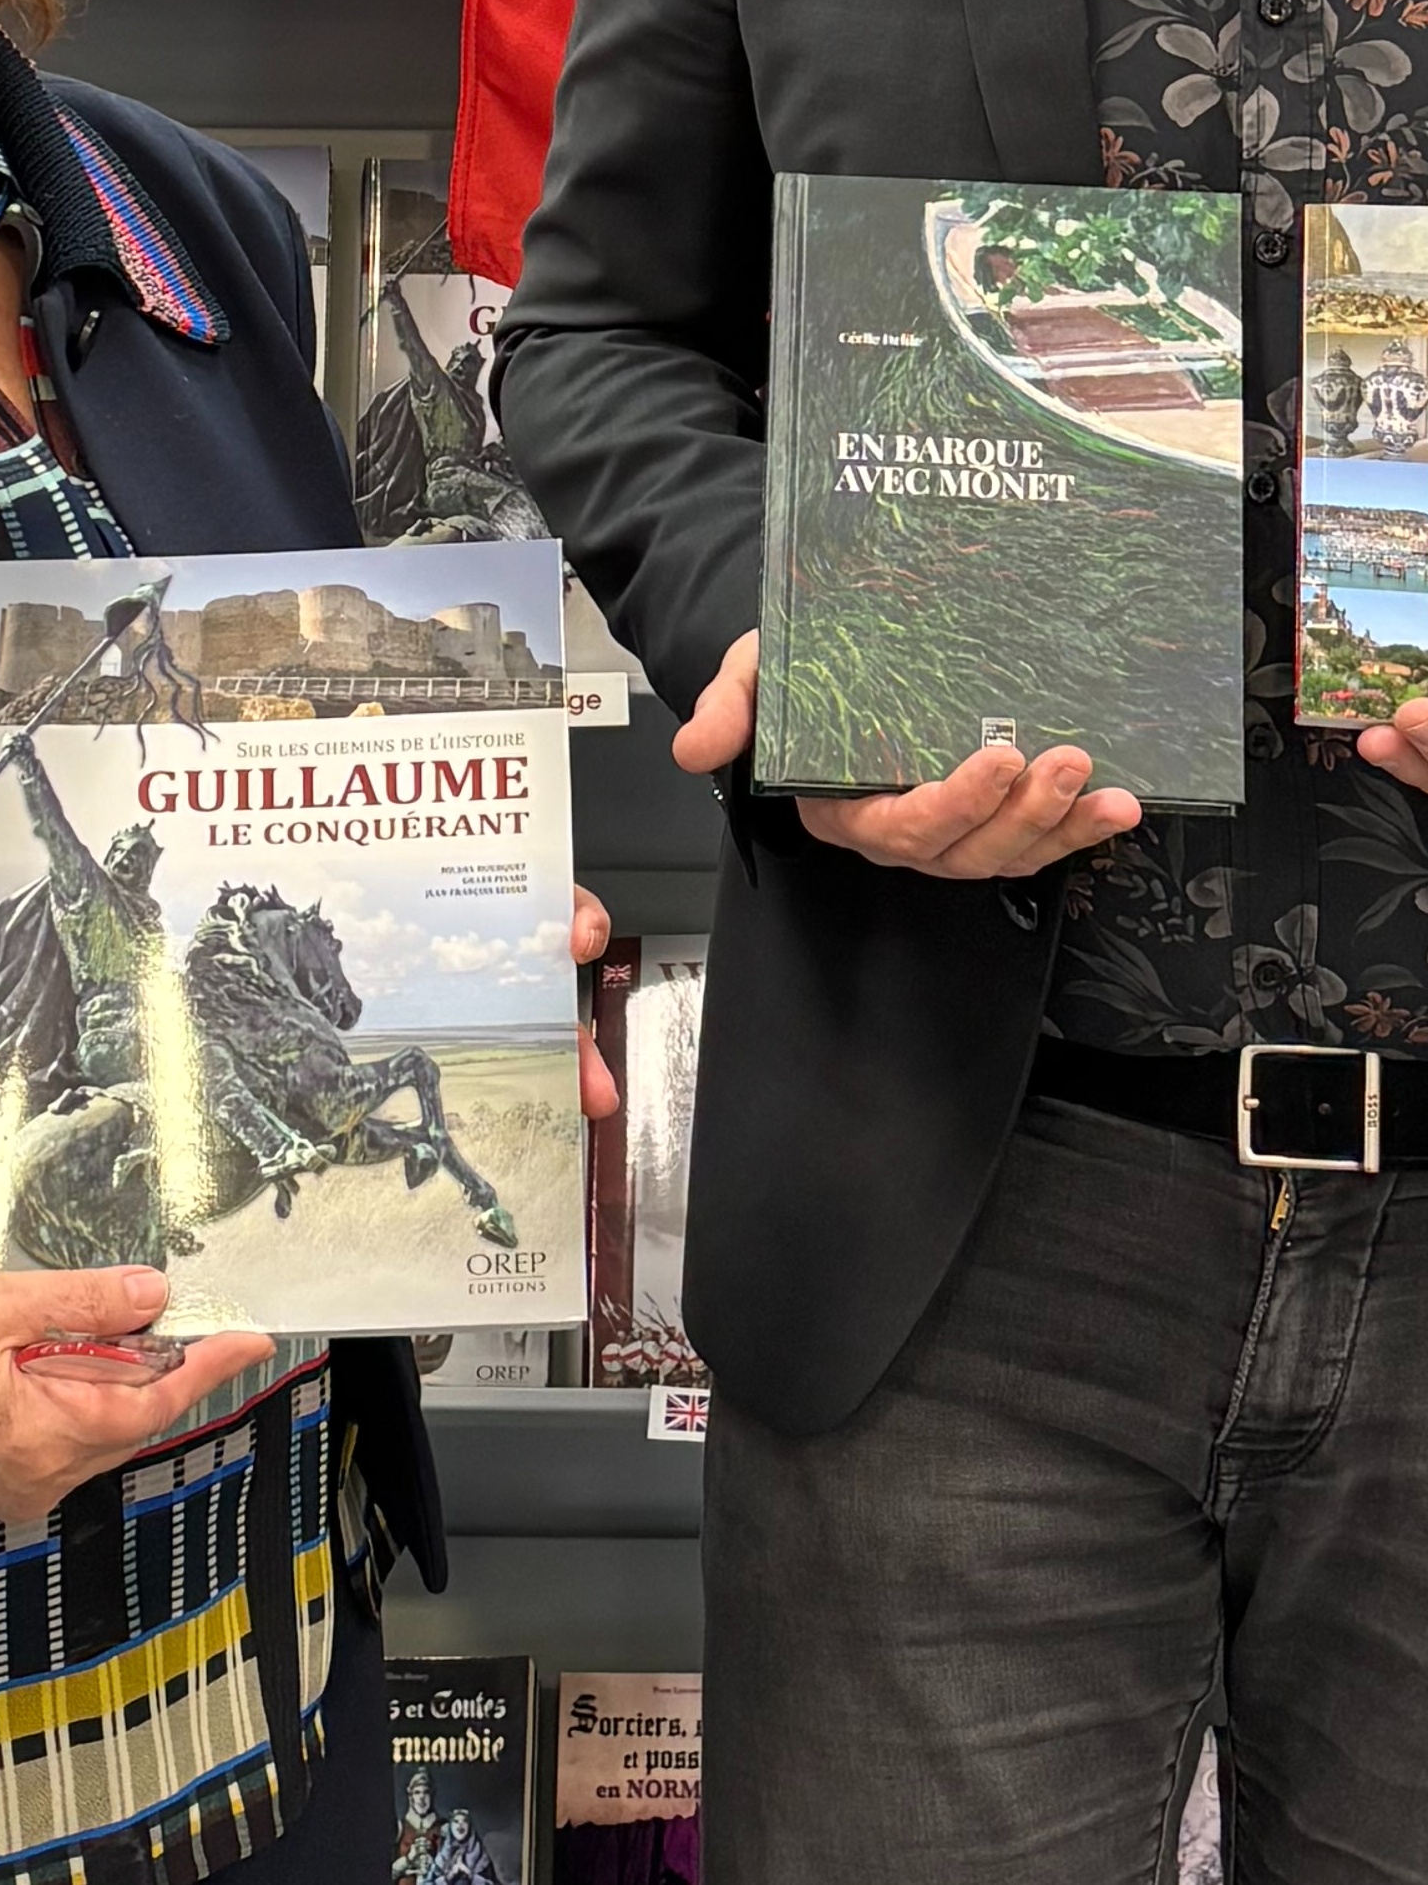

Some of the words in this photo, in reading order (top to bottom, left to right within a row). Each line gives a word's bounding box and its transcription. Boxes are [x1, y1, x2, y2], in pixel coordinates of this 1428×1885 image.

[837, 432, 886, 462] EN
[895, 434, 1043, 474] BARQUE
[834, 465, 930, 496] AVEC
[938, 468, 1075, 503] MONET
[237, 742, 273, 758] SUR
[279, 742, 309, 758] LES
[314, 739, 395, 756] CHEMINS
[401, 737, 424, 753] DE
[429, 732, 526, 750] L'HISTOIRE
[137, 756, 529, 813] GUILLAUME
[209, 823, 252, 847] LE
[264, 811, 530, 847] CONQUÉRANT
[1367, 1094, 1378, 1128] BOSS
[466, 1251, 547, 1276] OREP
[468, 1281, 547, 1295] EDITIONS
[476, 1365, 529, 1382] OREP
[406, 1701, 424, 1718] et
[430, 1689, 507, 1720] Contes
[623, 1751, 639, 1770] et
[596, 1783, 621, 1799] en
